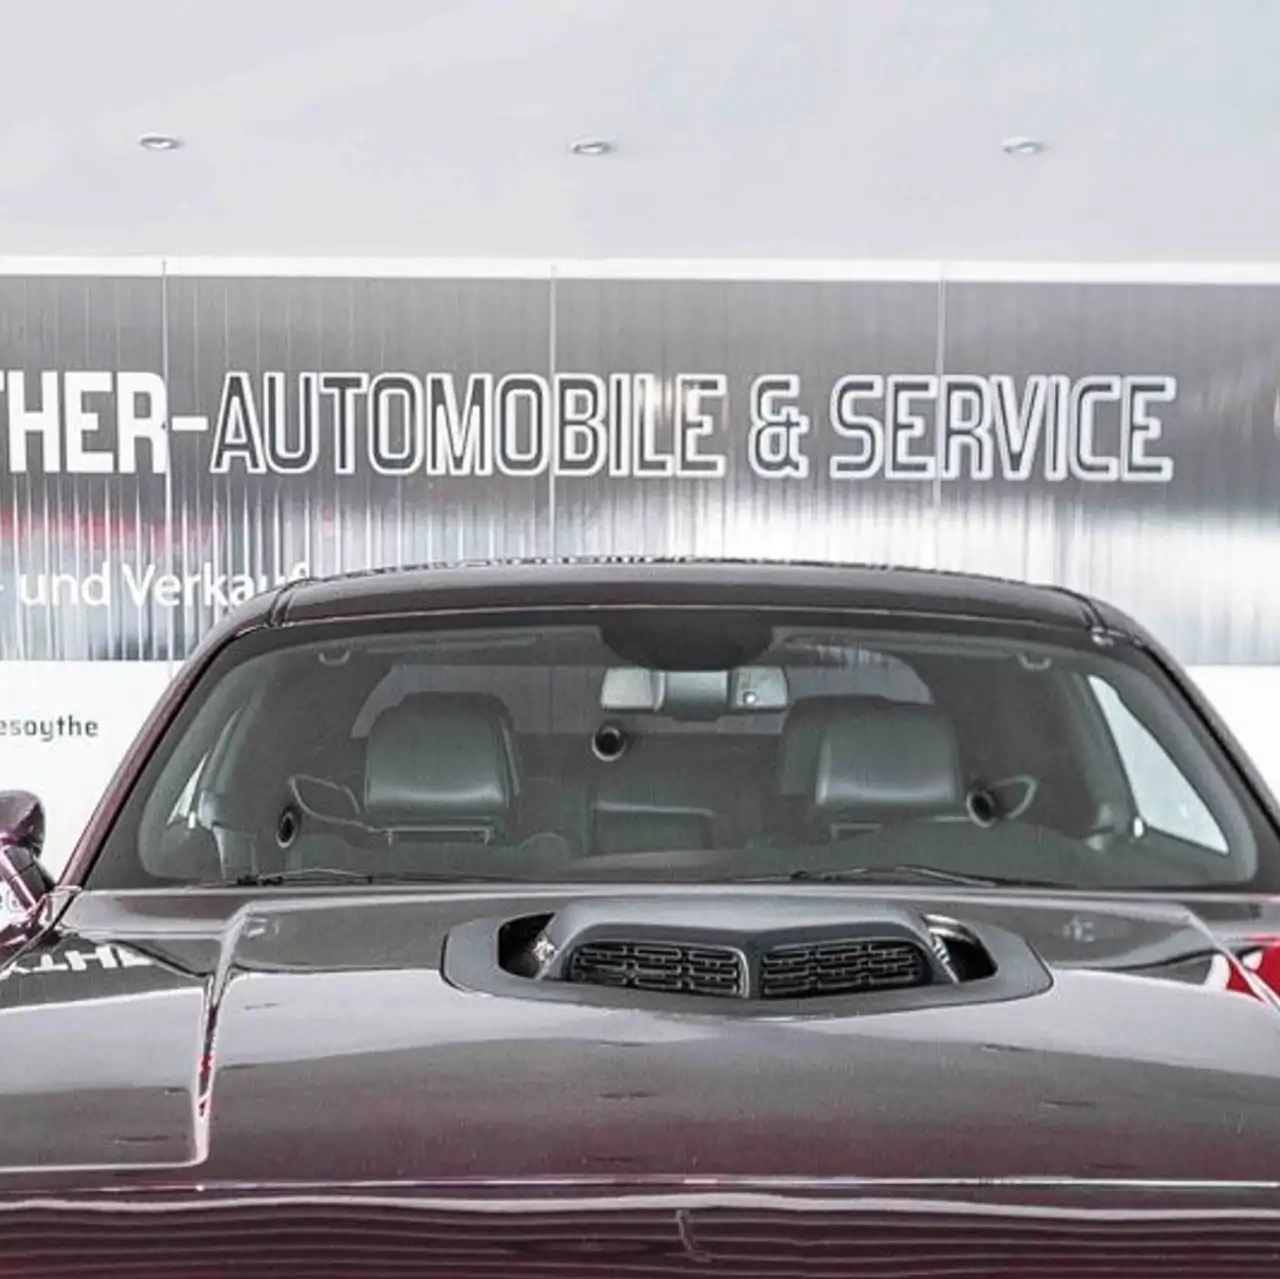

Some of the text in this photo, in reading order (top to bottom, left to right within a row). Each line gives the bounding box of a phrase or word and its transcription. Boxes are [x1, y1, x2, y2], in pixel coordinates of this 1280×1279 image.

[748, 373, 810, 481] &
[830, 374, 1177, 483] SERVICE
[19, 561, 111, 606] und
